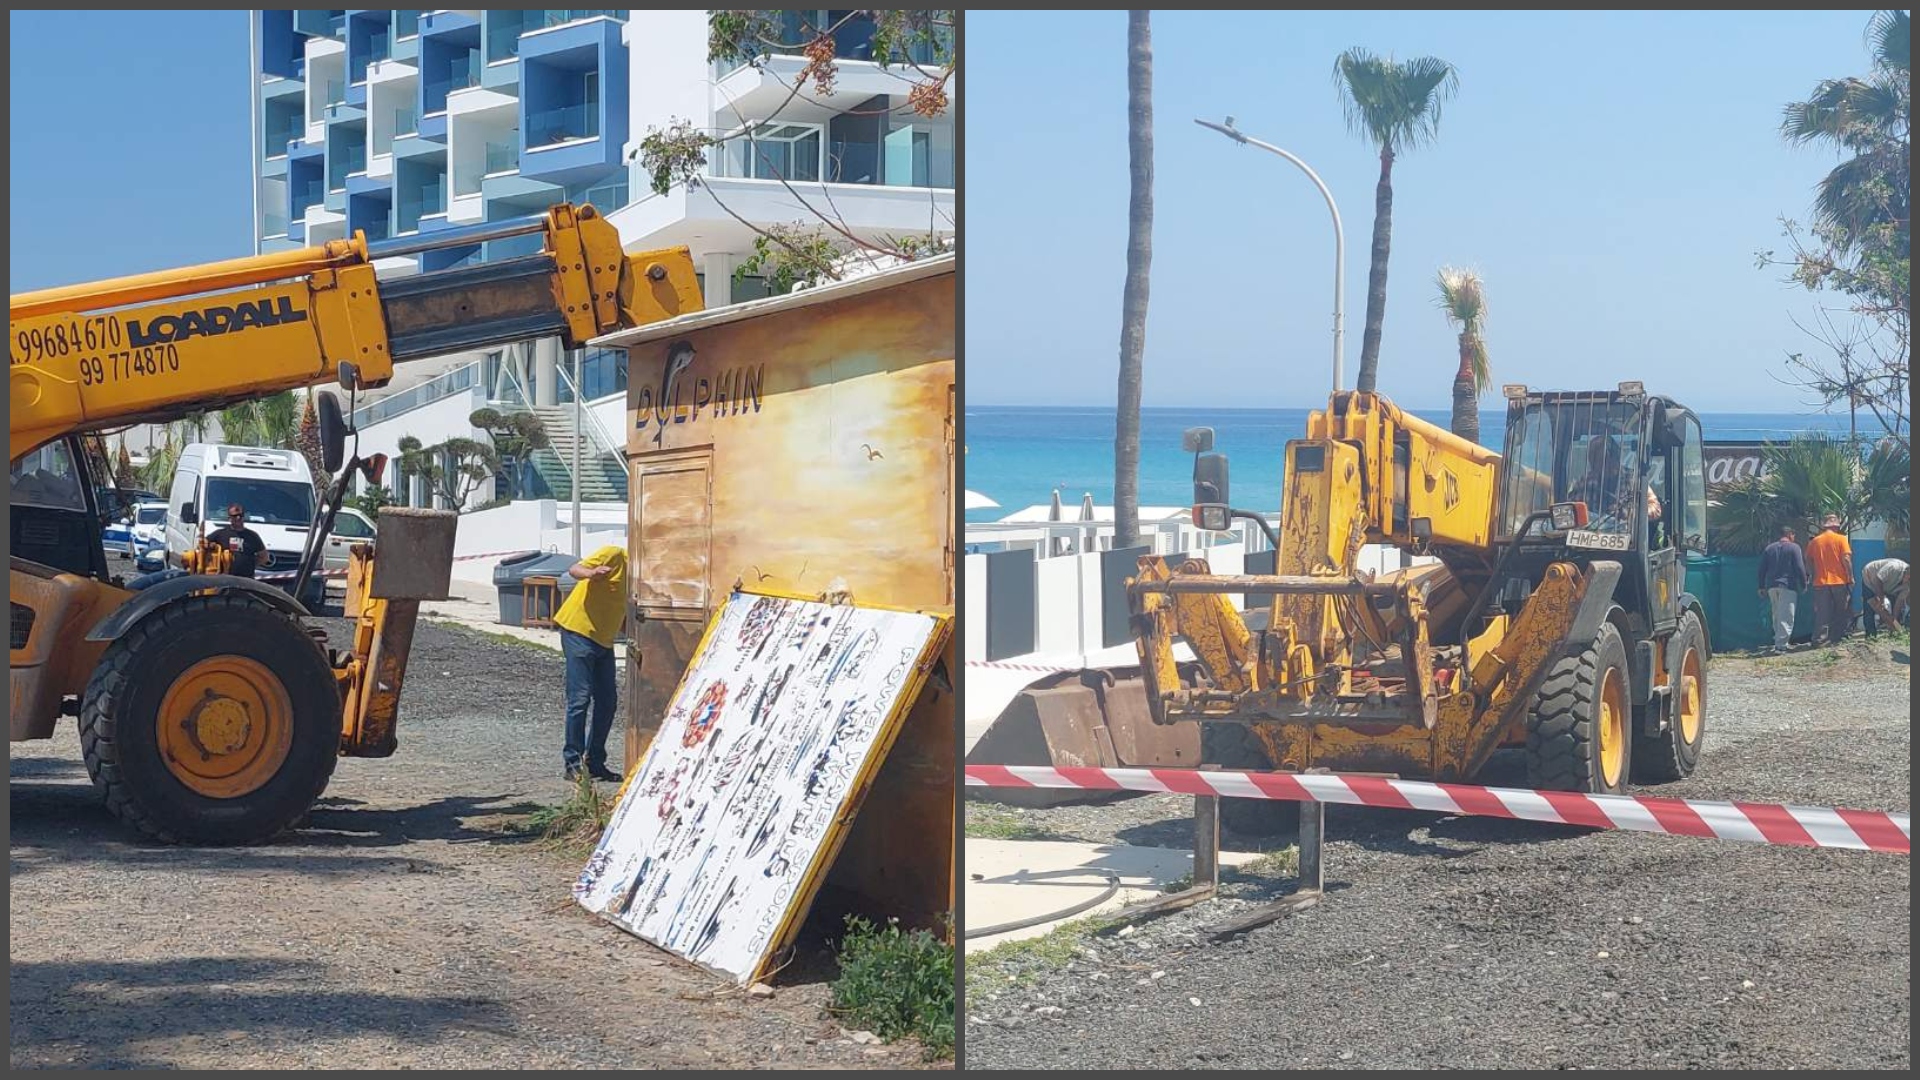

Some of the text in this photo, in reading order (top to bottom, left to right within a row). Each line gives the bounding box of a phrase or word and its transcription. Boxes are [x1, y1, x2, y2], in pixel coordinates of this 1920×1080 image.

[125, 296, 307, 348] LOADALL
[80, 343, 179, 386] 99 774870
[1444, 470, 1460, 511] JCB
[852, 646, 918, 744] POWER
[829, 711, 866, 755] FLY
[787, 758, 841, 837] WITH
[802, 749, 863, 842] WATER
[766, 838, 799, 879] US
[744, 847, 812, 956] SPORTS
